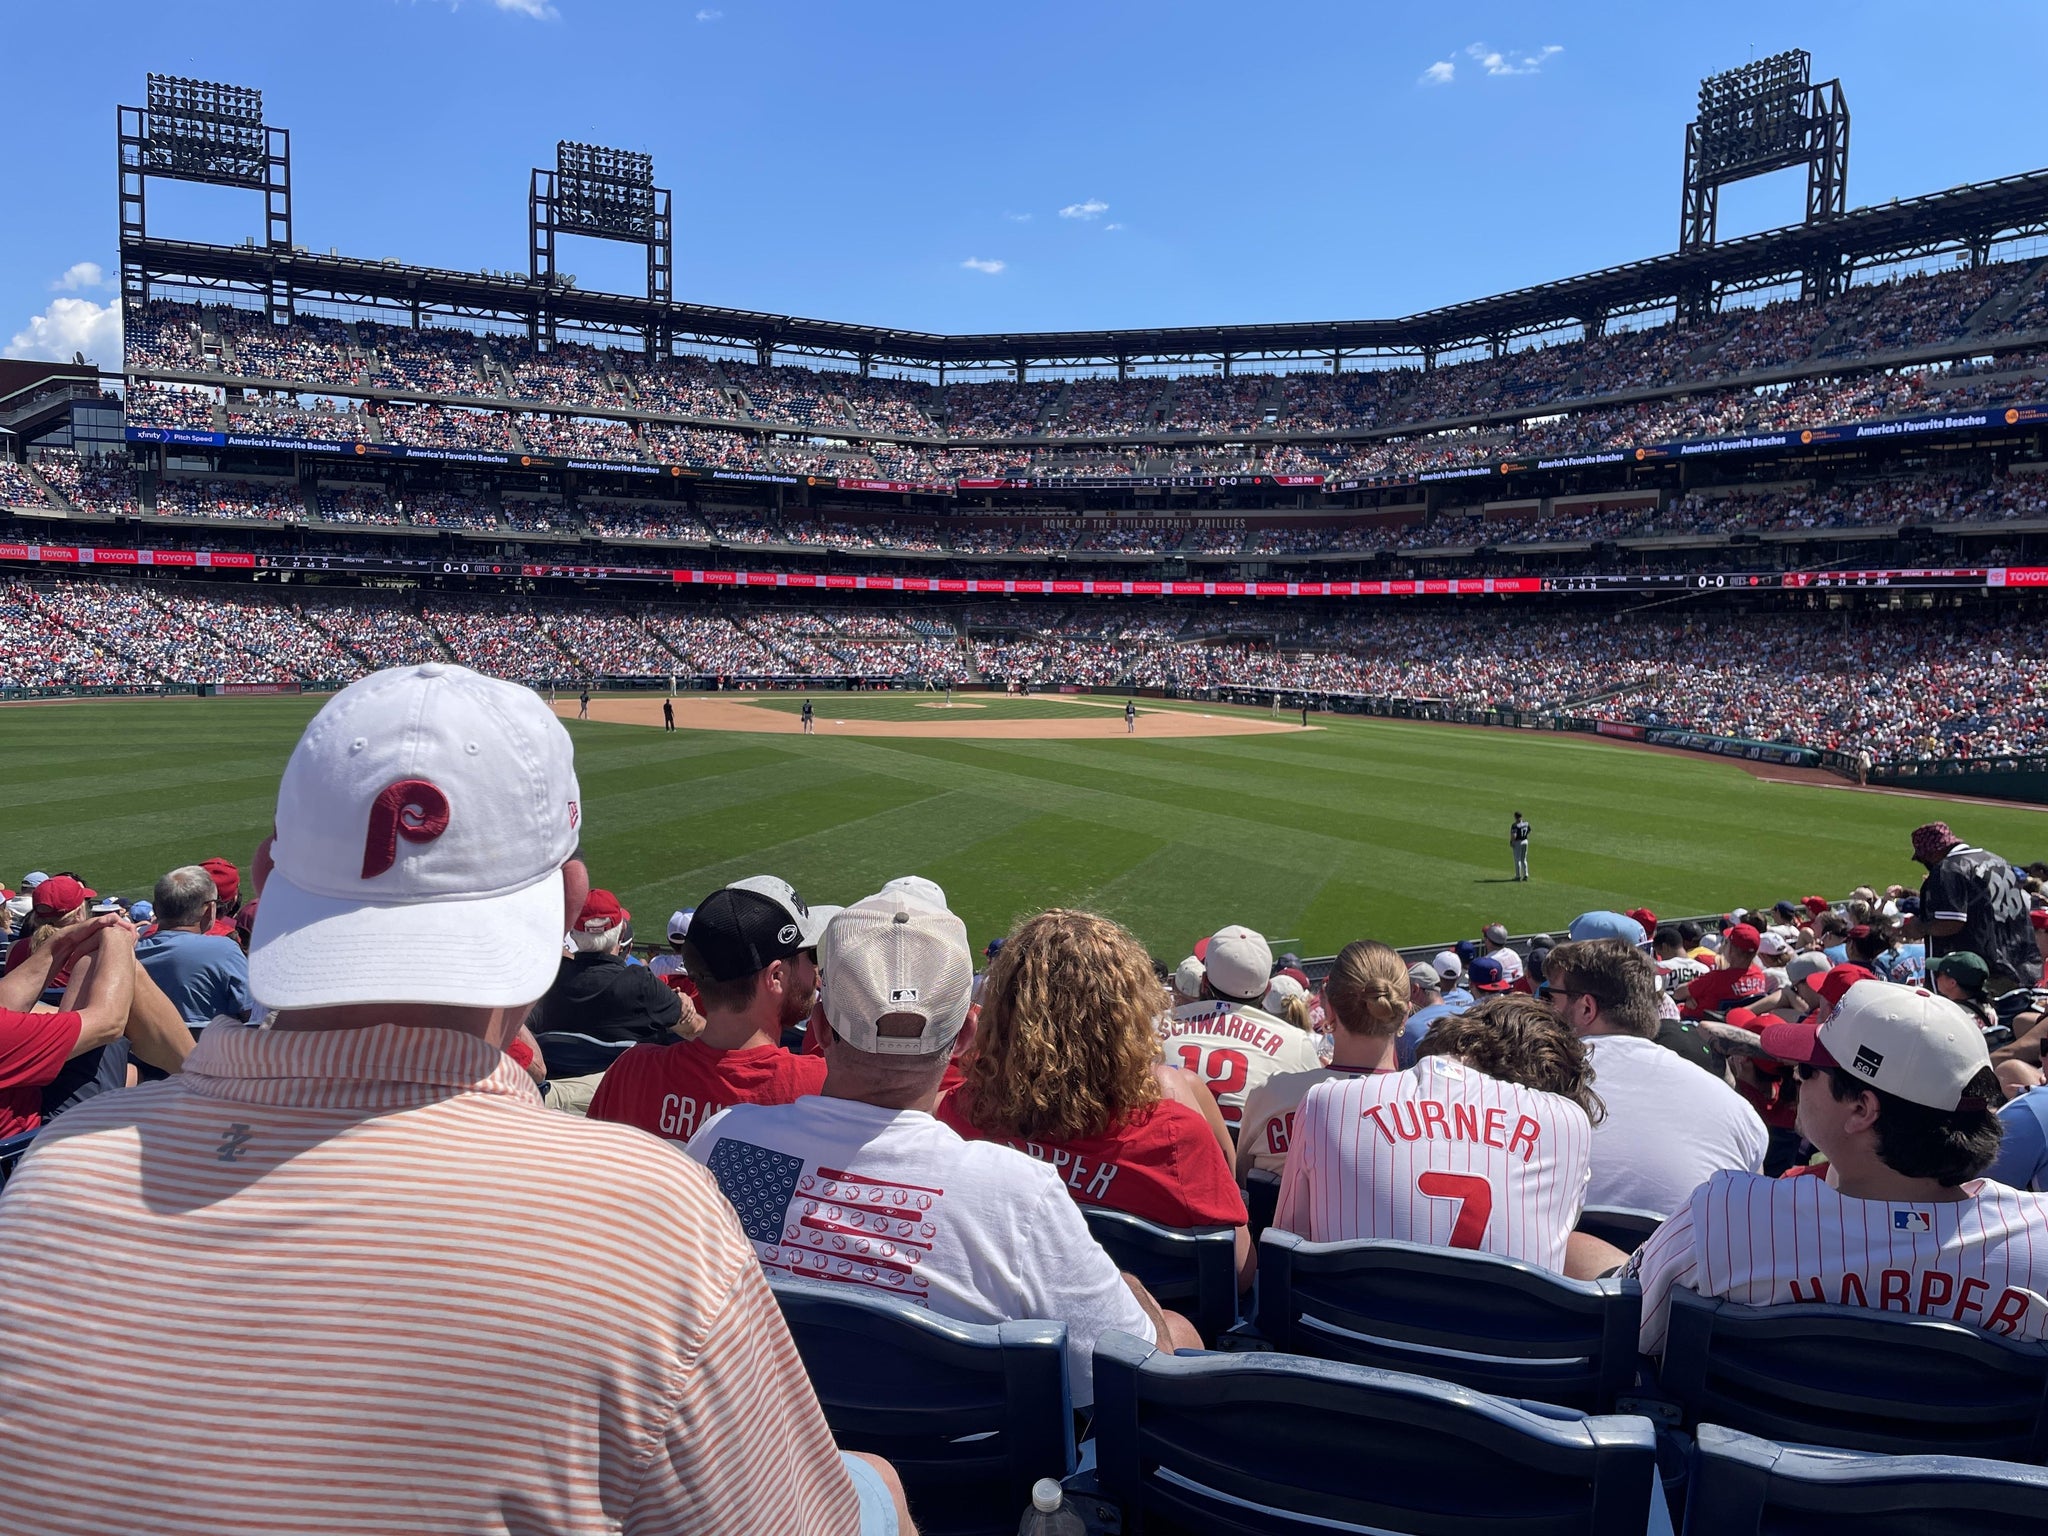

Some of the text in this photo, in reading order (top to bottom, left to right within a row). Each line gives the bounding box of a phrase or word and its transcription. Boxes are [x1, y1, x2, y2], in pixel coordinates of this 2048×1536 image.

[1857, 422, 1902, 437] America's
[1904, 418, 1944, 432] Favorite
[1945, 415, 1986, 428] Beaches
[137, 430, 161, 440] xfinity
[173, 433, 213, 443] Pitch Speed
[228, 436, 271, 447] America's
[271, 439, 306, 450] Favorite
[307, 442, 341, 453] Beaches
[1681, 443, 1717, 454] America's
[1718, 439, 1752, 451] Favorite
[1753, 436, 1786, 447] Beaches
[406, 449, 508, 463] America's Favorite Beaches
[1537, 458, 1568, 469] America's
[1569, 455, 1596, 466] Favorite
[1597, 453, 1624, 463] Beaches
[567, 461, 660, 474] America's Favorite Beaches
[1419, 467, 1491, 481] America's Favorite Beaches
[1042, 519, 1069, 529] HOME
[1075, 519, 1087, 529] OF
[1093, 519, 1111, 529] THE
[1198, 518, 1246, 529] PHILLIES
[43, 550, 72, 558] TOYOTA
[97, 552, 135, 560] TOYOTA
[157, 554, 193, 562] TOYOTA
[214, 556, 250, 564] TOYOTA
[474, 565, 490, 573] OUTS
[1730, 577, 1747, 585] OUTS
[2010, 571, 2048, 581] TOYOTA
[226, 685, 252, 693] RAV4th
[1158, 1012, 1284, 1056] SCHWARBER
[659, 1093, 722, 1138] GRA
[1363, 1100, 1541, 1163] TURNER
[1418, 1170, 1492, 1250] 7
